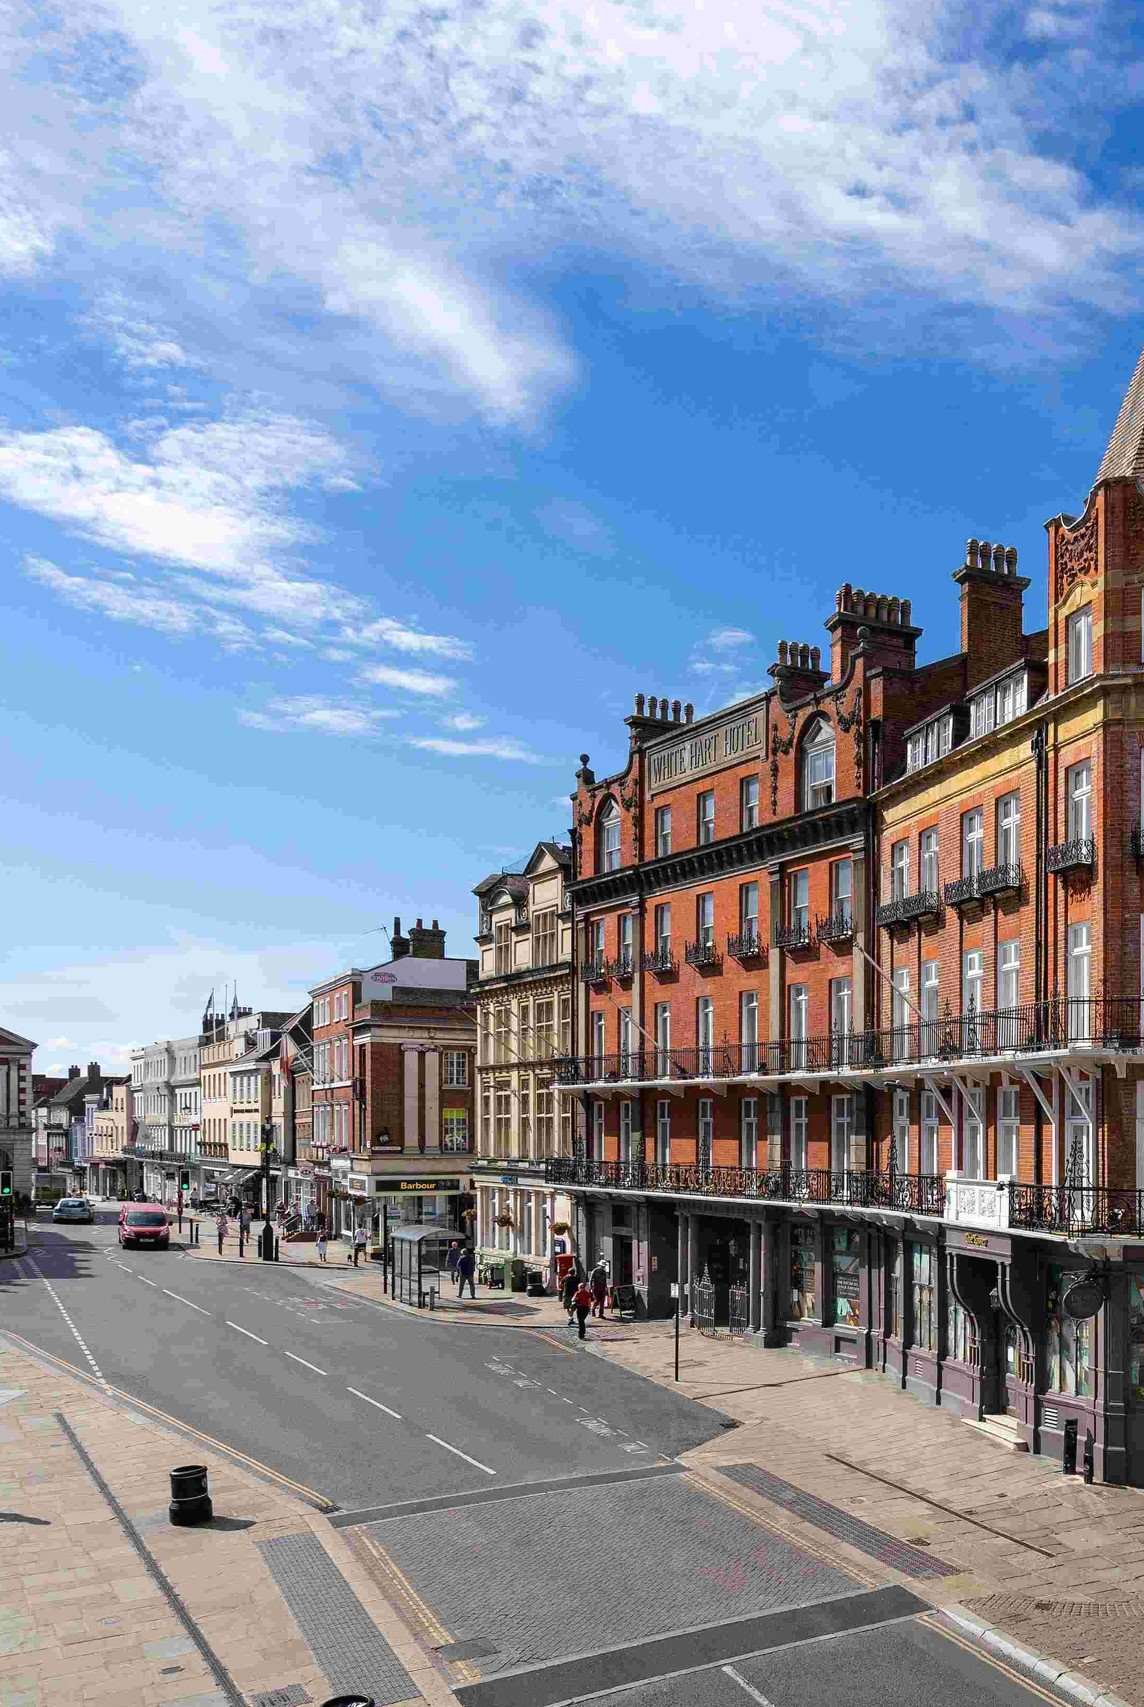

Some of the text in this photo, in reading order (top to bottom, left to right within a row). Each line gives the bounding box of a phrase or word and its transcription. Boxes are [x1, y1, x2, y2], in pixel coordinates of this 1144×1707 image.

[653, 716, 762, 784] WHITE HART HOTEL
[400, 1181, 437, 1190] Barbour
